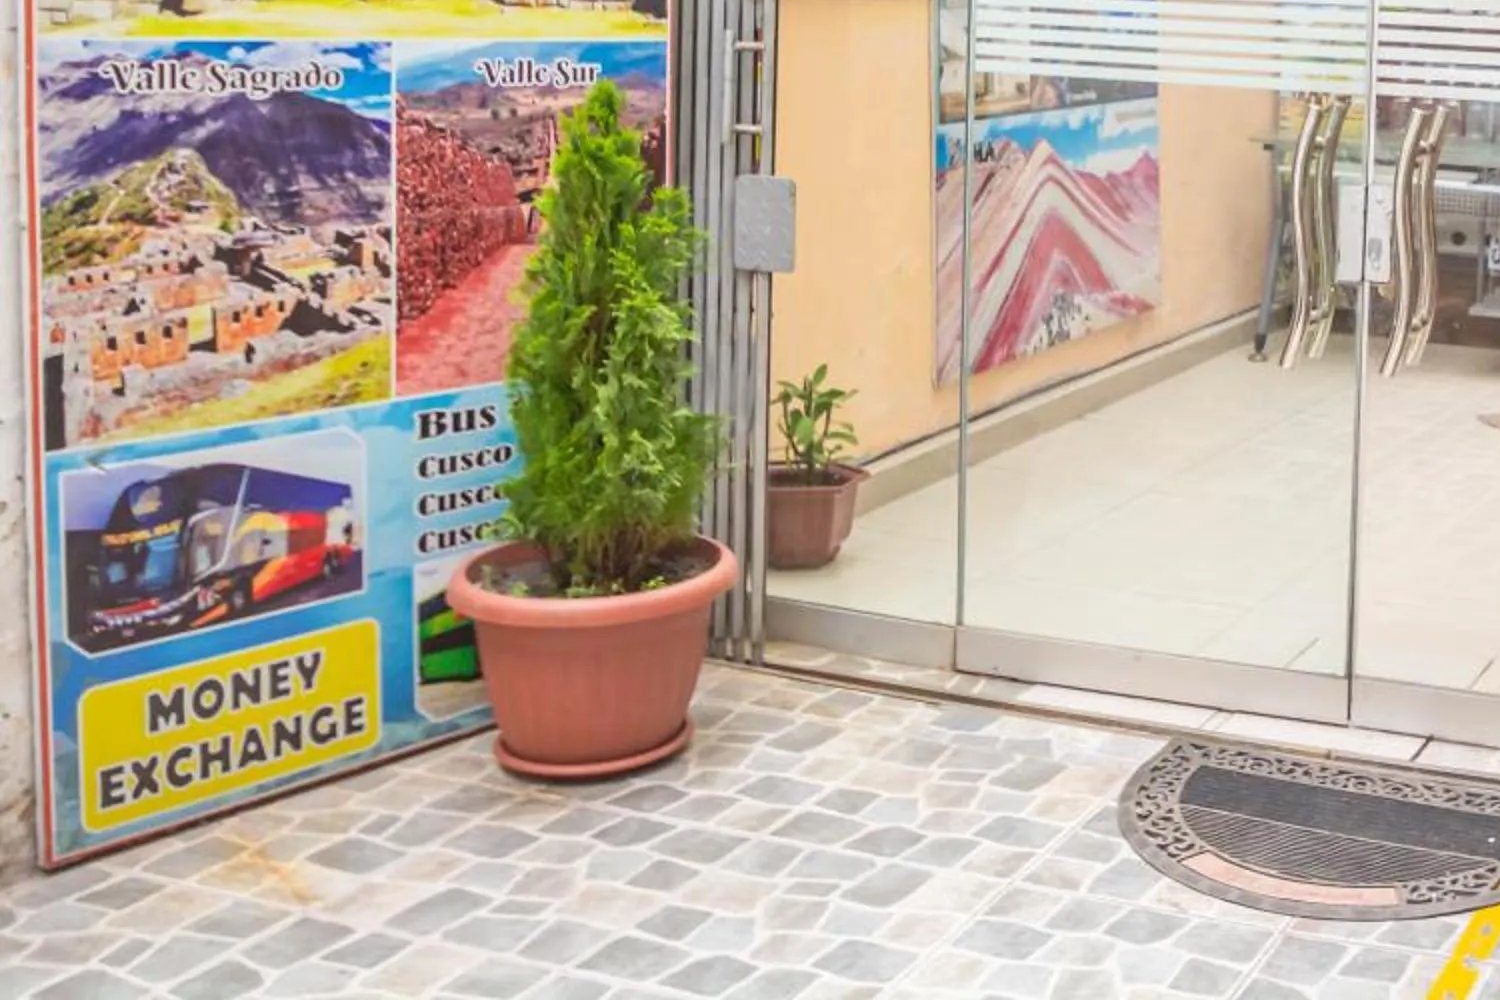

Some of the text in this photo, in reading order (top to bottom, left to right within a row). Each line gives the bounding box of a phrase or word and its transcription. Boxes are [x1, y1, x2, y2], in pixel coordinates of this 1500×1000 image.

[205, 59, 342, 100] Sagrado
[553, 57, 601, 88] Sur
[417, 405, 498, 441] Bus
[417, 445, 514, 479] Cusco
[147, 651, 323, 734] MONEY
[99, 696, 366, 810] EXCHANGE
